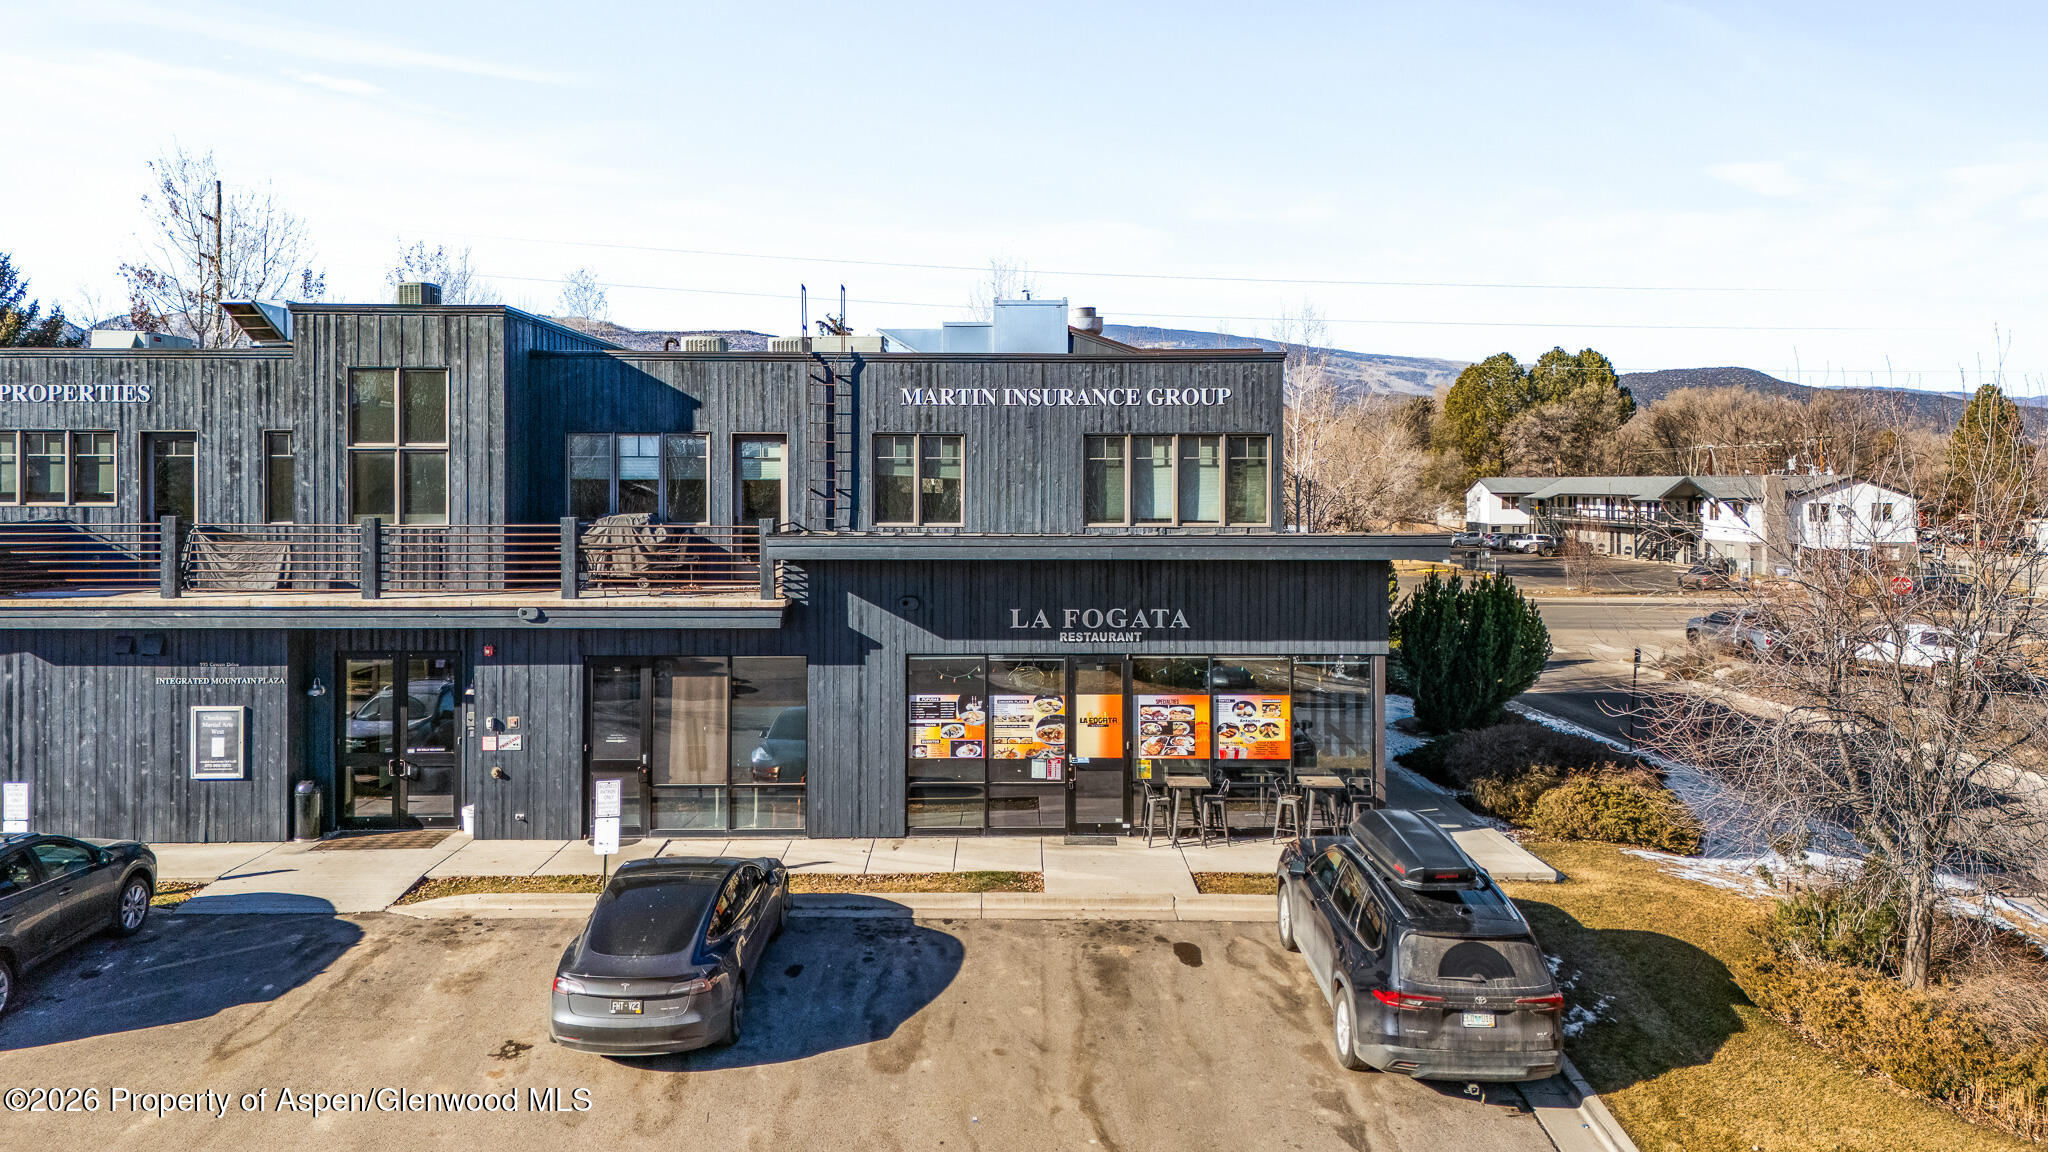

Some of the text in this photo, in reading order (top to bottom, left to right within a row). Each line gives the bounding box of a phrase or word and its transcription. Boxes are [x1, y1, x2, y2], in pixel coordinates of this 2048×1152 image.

[0, 384, 152, 403] PROPERTIES
[900, 387, 1233, 407] MARTIN INSURANCE GROUP
[1010, 608, 1191, 629] LA FOGATA
[1059, 631, 1143, 643] RESTAURANT
[155, 677, 286, 685] INTEGRATED MOUNTAIN PLAZA
